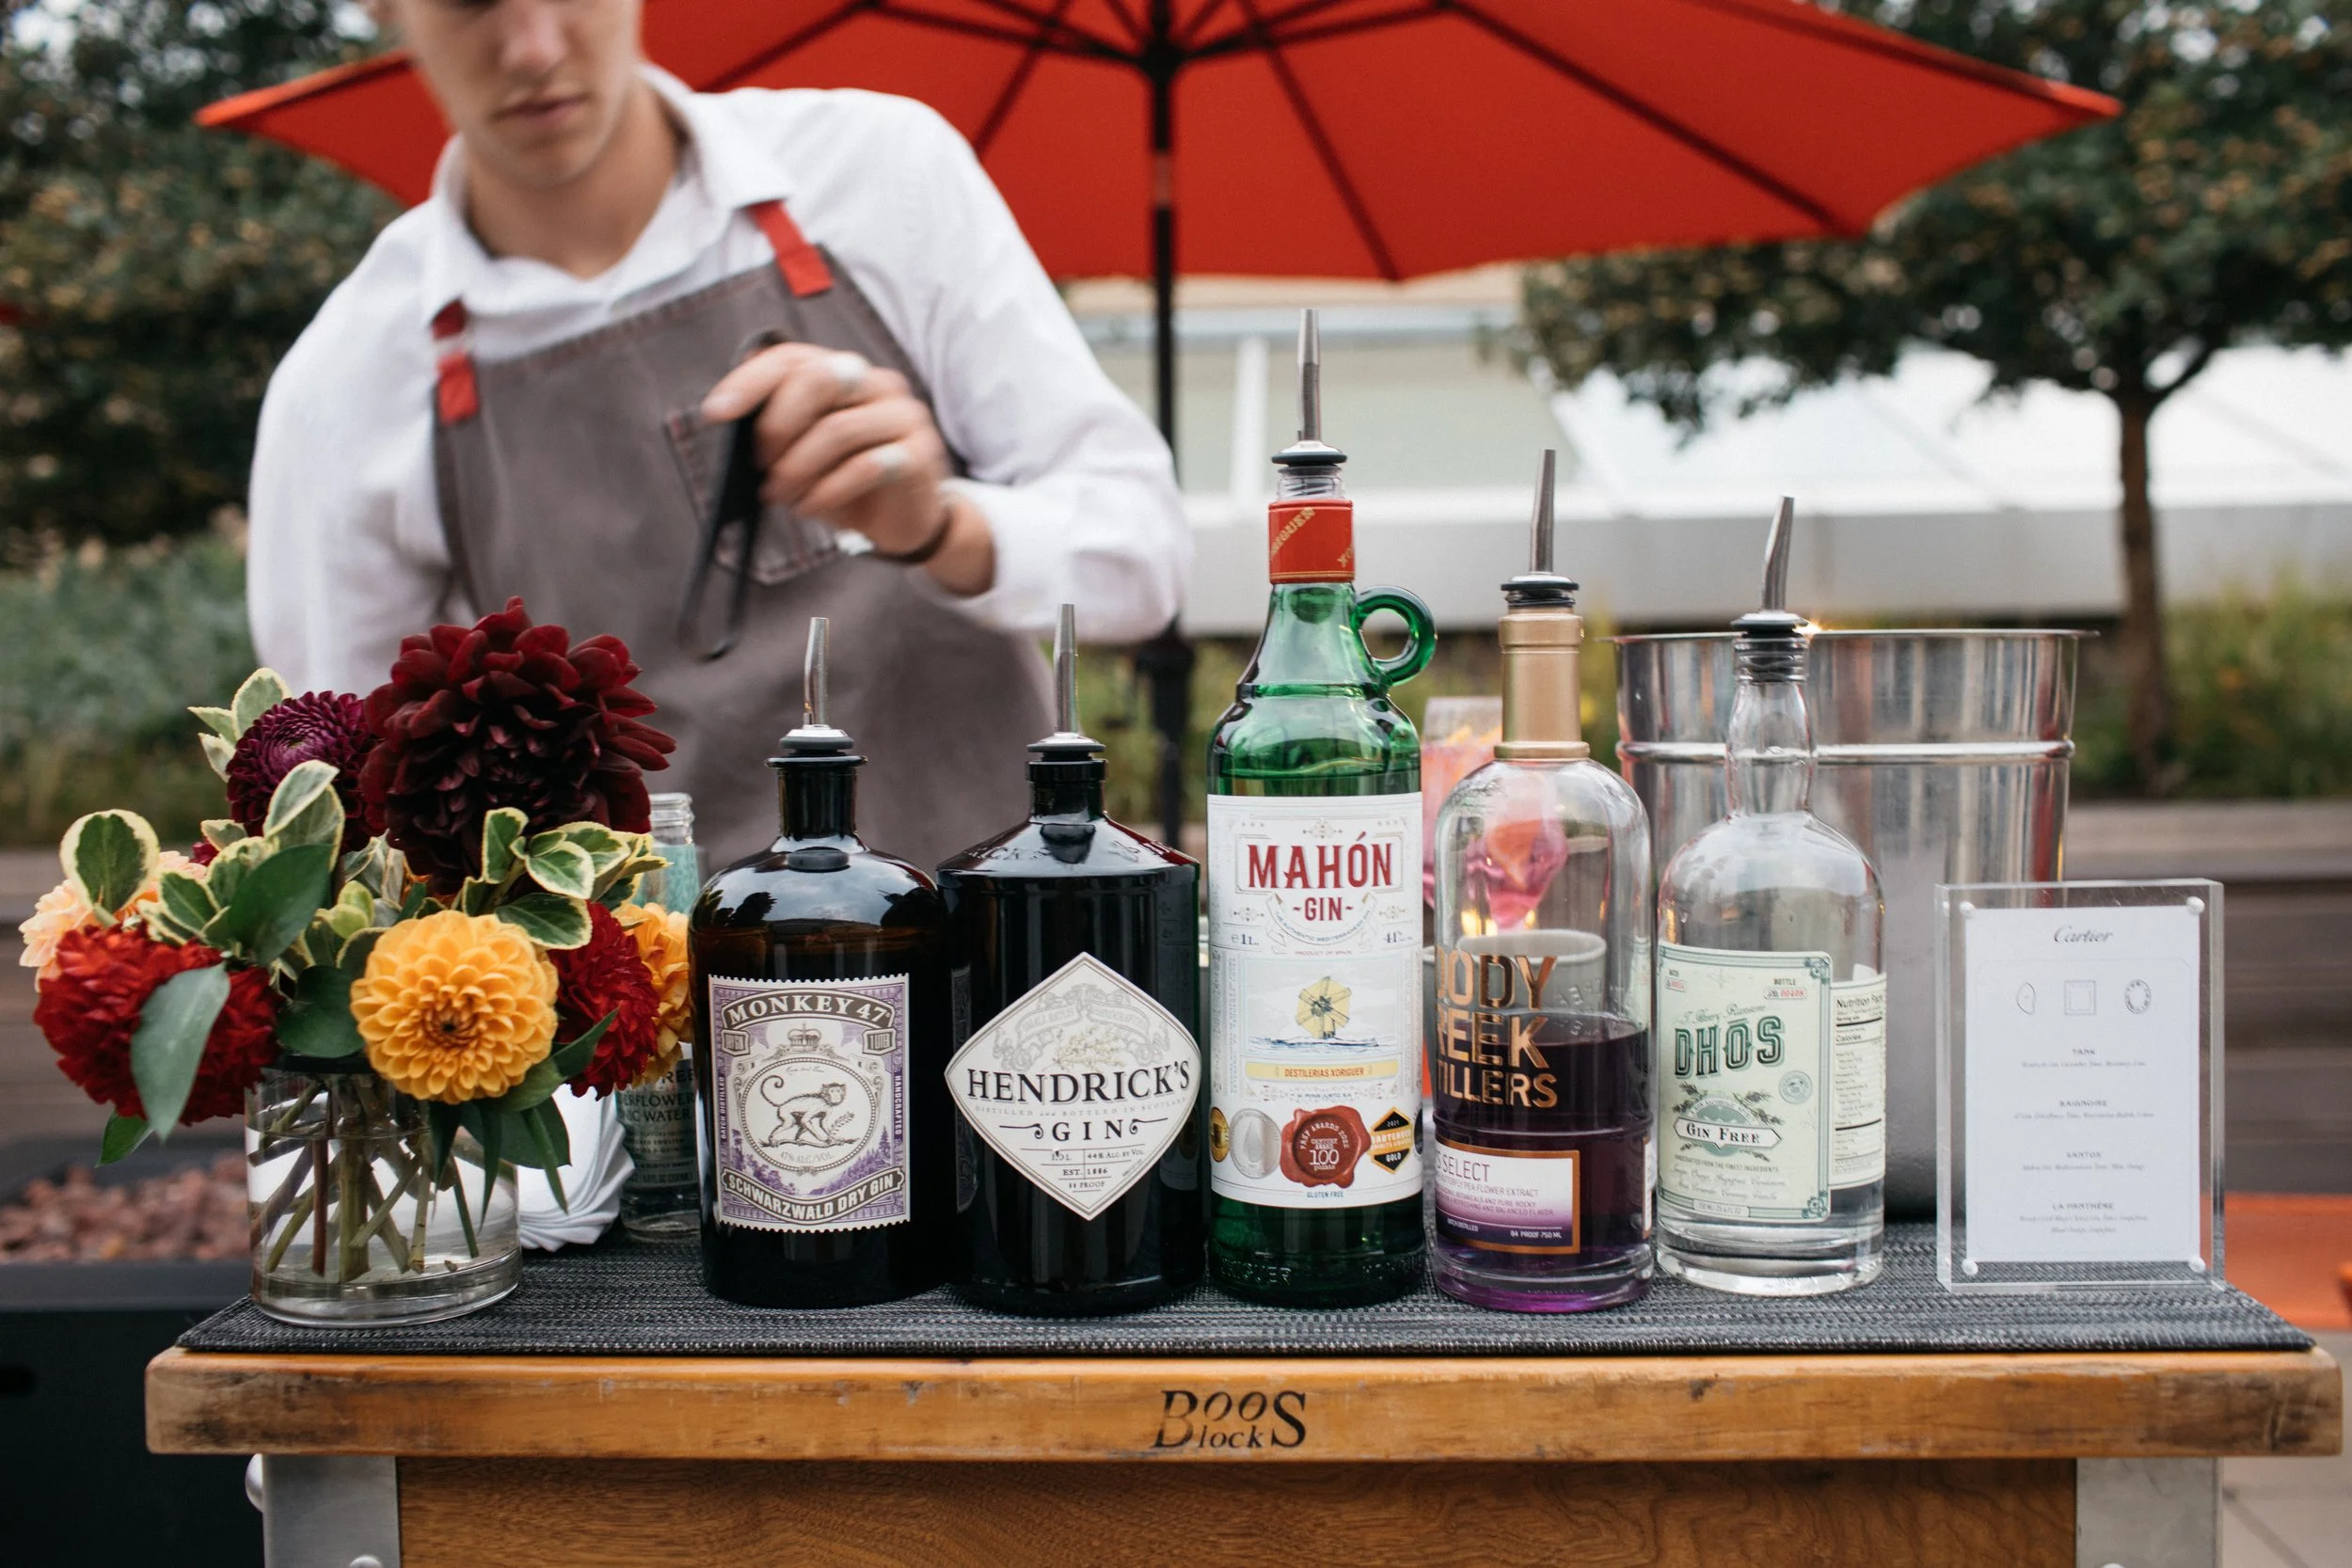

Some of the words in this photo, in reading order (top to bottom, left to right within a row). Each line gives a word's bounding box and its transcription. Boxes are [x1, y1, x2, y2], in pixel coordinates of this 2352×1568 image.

[1247, 831, 1392, 890] MAHÓN
[1304, 896, 1343, 922] GIN
[2053, 926, 2114, 944] Cartier
[726, 993, 855, 1026] MONKEY
[856, 1002, 888, 1022] 47
[967, 1059, 1190, 1103] HENDRICK'S
[644, 1107, 691, 1123] WATER
[894, 1074, 903, 1135] HANDCRAFTED
[1051, 1118, 1123, 1142] GIN
[1309, 1148, 1341, 1166] 100
[1442, 1153, 1491, 1183] SELECT
[727, 1172, 834, 1221] SCHWARZWALD
[837, 1189, 868, 1213] DRY
[869, 1173, 895, 1197] GIN
[1506, 1187, 1540, 1198] EXTRACT
